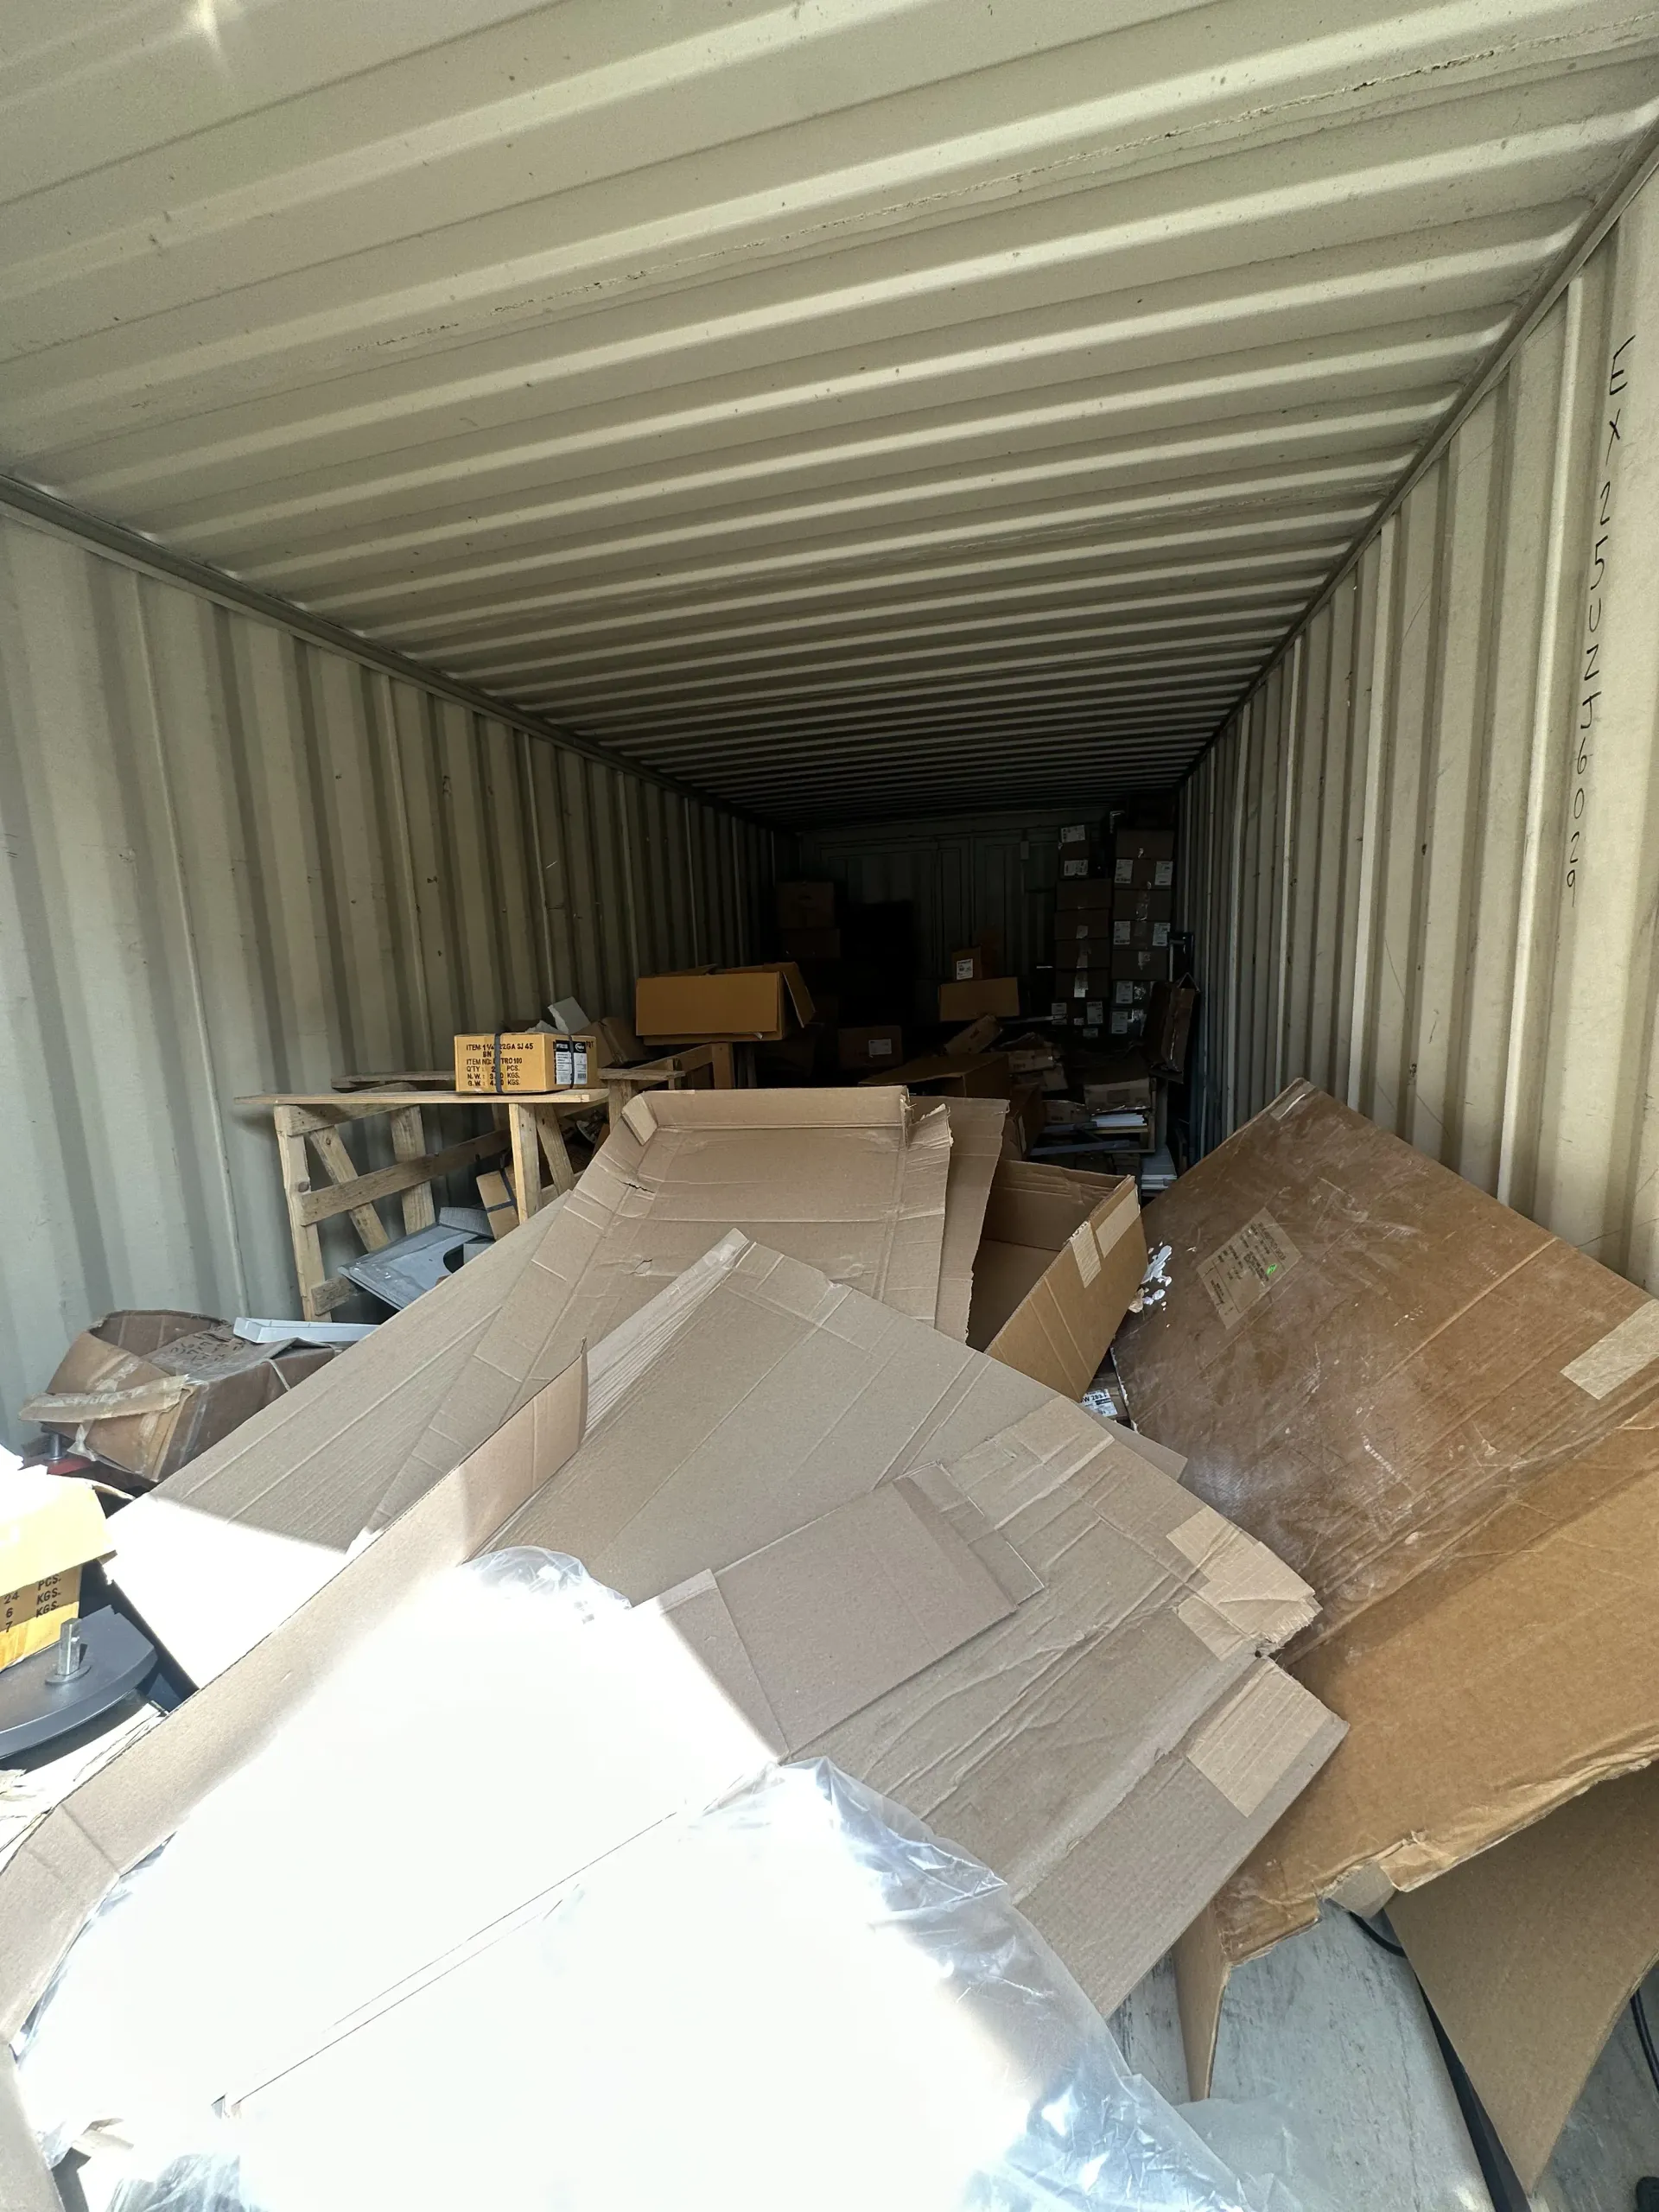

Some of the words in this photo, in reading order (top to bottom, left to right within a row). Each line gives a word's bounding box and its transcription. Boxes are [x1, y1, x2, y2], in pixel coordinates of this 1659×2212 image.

[3, 1592, 20, 1605] 24
[37, 1573, 61, 1591] PCS.
[6, 1607, 13, 1618] 6
[36, 1587, 61, 1605] KGS.
[5, 1621, 13, 1633] 7
[35, 1600, 60, 1618] KGS.
